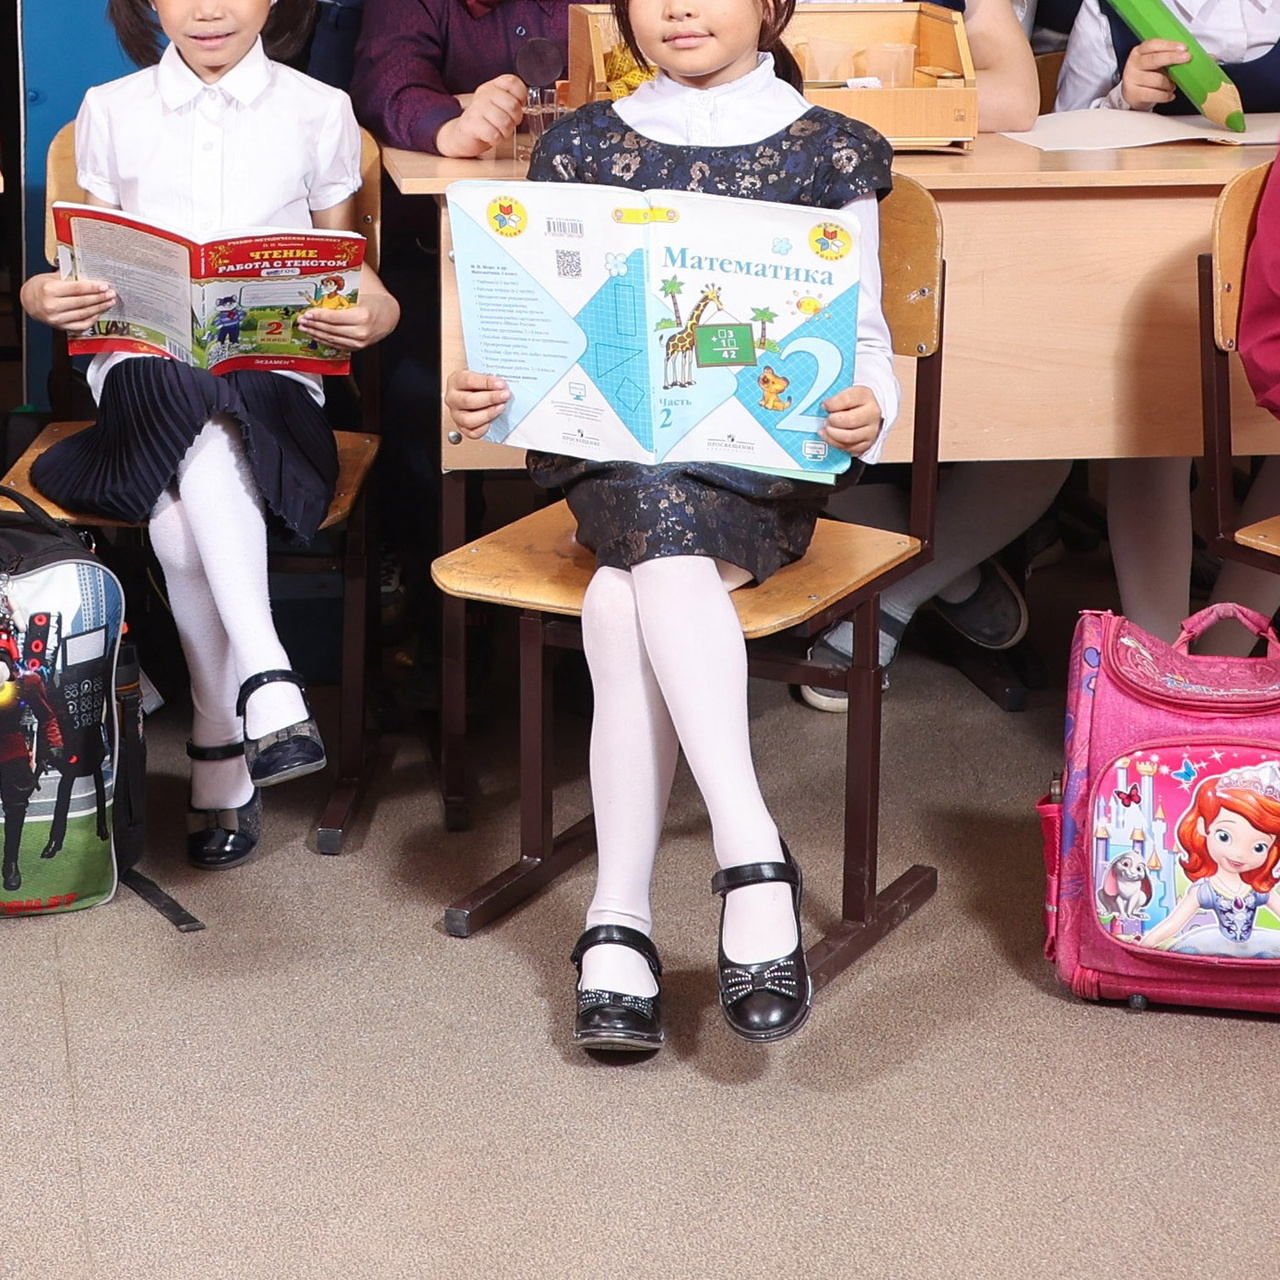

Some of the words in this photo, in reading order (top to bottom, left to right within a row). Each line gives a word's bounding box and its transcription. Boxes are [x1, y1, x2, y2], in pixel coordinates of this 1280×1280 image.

[249, 249, 318, 260] ЧТЕНИЕ
[217, 260, 270, 274] РАБОТА
[273, 260, 282, 268] С
[285, 259, 347, 268] ТЕКСТОМ
[662, 246, 835, 286] Математика
[265, 321, 284, 335] 2
[727, 330, 734, 338] 3
[721, 339, 726, 347] 1
[722, 350, 737, 358] 42
[775, 335, 844, 433] 2
[660, 408, 673, 428] 2
